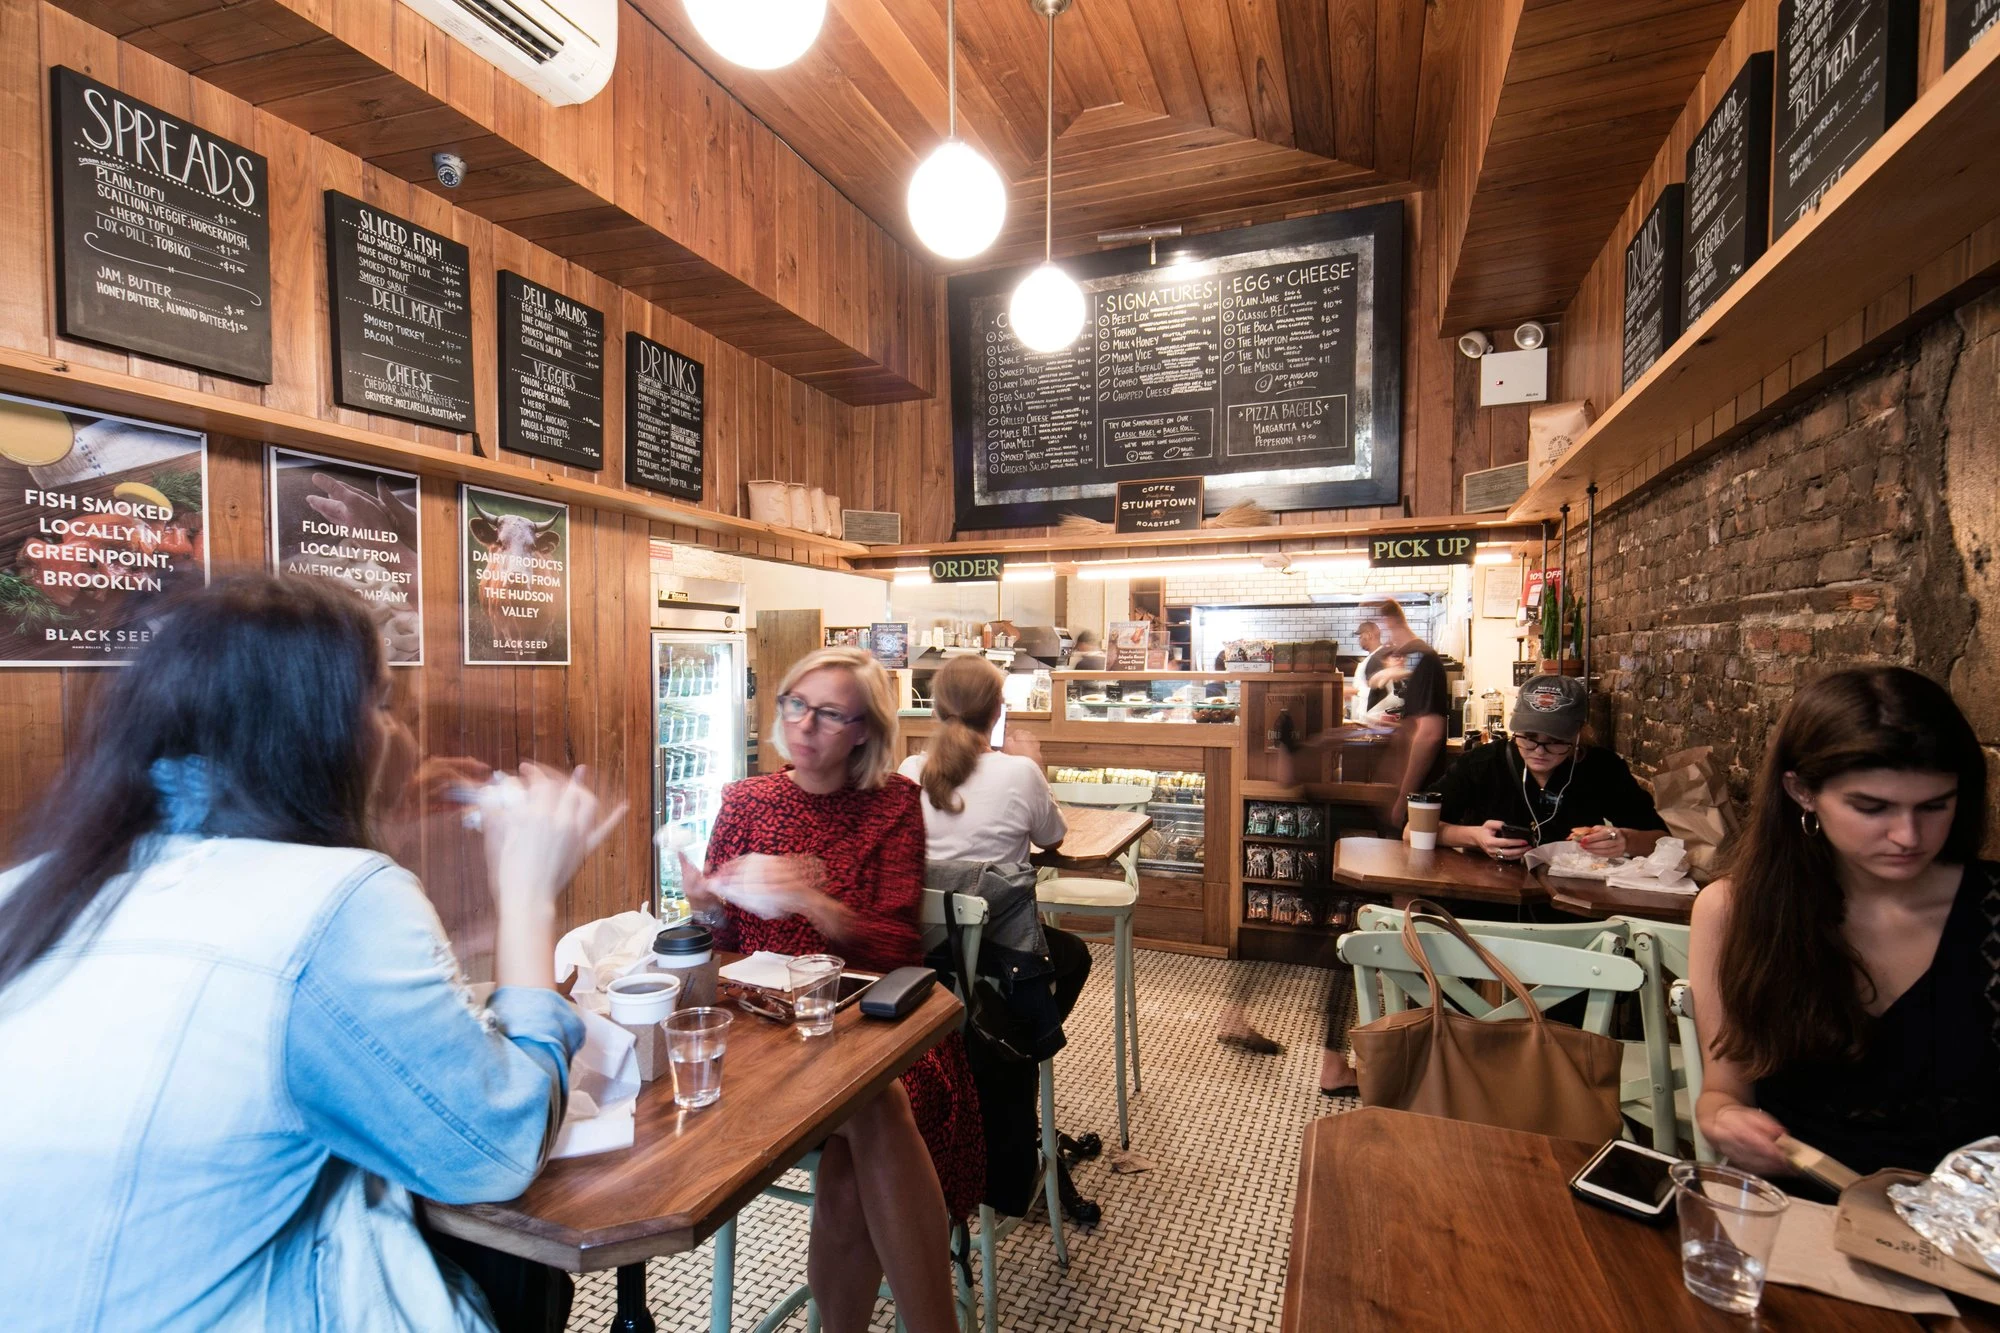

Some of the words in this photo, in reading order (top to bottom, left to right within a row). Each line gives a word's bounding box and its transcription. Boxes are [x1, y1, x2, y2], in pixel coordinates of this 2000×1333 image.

[1812, 13, 1834, 50] TROUT
[1796, 73, 1819, 128] DELI
[1825, 24, 1858, 90] MEAT
[1695, 130, 1713, 169] DELI
[1712, 88, 1738, 142] SALADS
[1789, 134, 1813, 168] SMOKED
[1813, 100, 1840, 142] TURKEY
[82, 88, 255, 207] SPREADS
[1789, 152, 1812, 188] BACON
[135, 181, 165, 202] TOFU
[116, 207, 145, 226] HERB
[146, 218, 174, 236] TOFU
[96, 216, 118, 234] LOX
[153, 236, 191, 259] TOBIKO
[360, 210, 407, 244] SLICED
[413, 232, 442, 260] FISH
[1695, 214, 1726, 269] VEGGIES
[358, 231, 375, 244] COLD
[377, 239, 401, 255] SMOKED
[403, 248, 426, 265] SALMON
[1627, 207, 1660, 294] DRINKS
[357, 243, 376, 257] HOUSE
[378, 252, 398, 265] CURED
[400, 260, 416, 274] BEET
[419, 266, 431, 279] LOX
[359, 257, 386, 274] SMOKED
[387, 267, 409, 283] TROUT
[128, 274, 172, 299] BUTTER
[360, 270, 385, 286] SMOKED
[387, 280, 408, 295] SABLE
[1233, 273, 1270, 293] EGG
[1287, 262, 1351, 286] CHEESE
[96, 281, 126, 300] HONEY
[166, 301, 198, 320] ALMOND
[199, 312, 228, 330] BUTTER
[524, 285, 546, 309] DELI
[555, 299, 587, 327] SALADS
[1106, 281, 1212, 312] SIGNATURES
[1236, 295, 1258, 307] PLAIN
[1261, 293, 1279, 304] JANE
[372, 287, 404, 315] DELI
[411, 301, 443, 328] MEAT
[522, 302, 533, 314] EGG
[534, 308, 552, 322] SALAD
[1112, 314, 1132, 325] BEET
[1134, 311, 1149, 322] LOX
[1237, 310, 1268, 321] CLASSIC
[1271, 304, 1289, 317] BEC
[364, 314, 394, 331] SMOKED
[396, 325, 424, 342] TURKEY
[364, 328, 394, 345] BACON
[521, 313, 533, 325] LINE
[535, 320, 554, 333] CAUGHT
[556, 327, 569, 339] TUNA
[1112, 327, 1136, 338] TOBIKO
[1236, 323, 1250, 335] THE
[1254, 321, 1274, 334] BOCA
[521, 335, 544, 352] CHICKEN
[545, 344, 562, 358] SALAD
[522, 324, 543, 339] SMOKED
[544, 333, 572, 350] WHITEFISH
[1113, 340, 1130, 350] MILK
[1136, 336, 1159, 348] HONEY
[1237, 336, 1252, 348] THE
[1254, 335, 1288, 346] HAMPTON
[999, 356, 1020, 366] SABLE
[1112, 353, 1133, 362] MIAMI
[1135, 350, 1153, 360] VICE
[1237, 350, 1253, 362] THE
[1257, 348, 1270, 359] NJ
[387, 362, 434, 392] CHEESE
[534, 361, 576, 390] VEGGIES
[641, 341, 696, 394] DRINKS
[1000, 367, 1024, 378] SMOKED
[1024, 364, 1045, 374] TROUT
[1112, 365, 1134, 376] VEGGIE
[1135, 362, 1161, 373] BUFFALO
[1238, 363, 1252, 374] THE
[1254, 362, 1284, 373] MENSCH
[1290, 371, 1318, 379] AVOCADO
[999, 381, 1018, 389] LARRY
[1020, 378, 1037, 387] DAVID
[1113, 378, 1138, 388] COMBO
[999, 393, 1012, 402] EGG
[1014, 390, 1035, 400] SALAD
[1113, 390, 1143, 402] CHOPPED
[1146, 386, 1171, 398] CHEESE
[528, 399, 546, 411] HERBS
[1245, 405, 1279, 421] PIZZA
[1282, 400, 1322, 419] BAGELS
[1000, 416, 1025, 426] GRILLED
[1026, 414, 1049, 423] CHEESE
[1253, 422, 1297, 435] MARGARITA
[540, 434, 563, 447] LETTUCE
[1000, 429, 1020, 438] MAPLE
[1023, 425, 1038, 436] BLT
[1255, 436, 1294, 447] PEPPERONI
[1000, 441, 1016, 449] TUNA
[1017, 438, 1035, 448] MELT
[1001, 451, 1023, 462] SMOKED
[1024, 450, 1044, 460] TURKEY
[1000, 463, 1027, 474] CHICKEN
[1029, 461, 1049, 471] SALAD
[25, 489, 75, 509] FISH
[82, 497, 173, 521] SMOKED
[1122, 498, 1196, 510] STUMPTOWN
[40, 518, 135, 541] LOCALLY
[140, 528, 161, 544] IN
[303, 521, 349, 538] FLOUR
[352, 527, 398, 543] MILLED
[1137, 519, 1180, 527] ROASTERS
[27, 543, 174, 571] GREENPOINT,
[301, 542, 360, 559] LOCALLY
[364, 549, 400, 563] FROM
[1374, 539, 1430, 560] PICK
[1437, 537, 1470, 556] UP
[473, 551, 507, 564] DAIRY
[509, 555, 563, 572] PRODUCTS
[932, 559, 1000, 578] ORDER
[43, 571, 161, 592] BROOKLYN
[288, 562, 362, 580] AMERICA'S
[365, 570, 412, 584] OLDEST
[476, 569, 528, 585] SOURCED
[531, 576, 560, 587] FROM
[1546, 570, 1561, 579] OFF
[485, 587, 506, 599] THE
[508, 589, 553, 603] HUDSON
[501, 606, 539, 618] VALLEY
[45, 628, 111, 641] BLACK
[493, 640, 523, 648] BLACK
[525, 641, 547, 649] SEED
